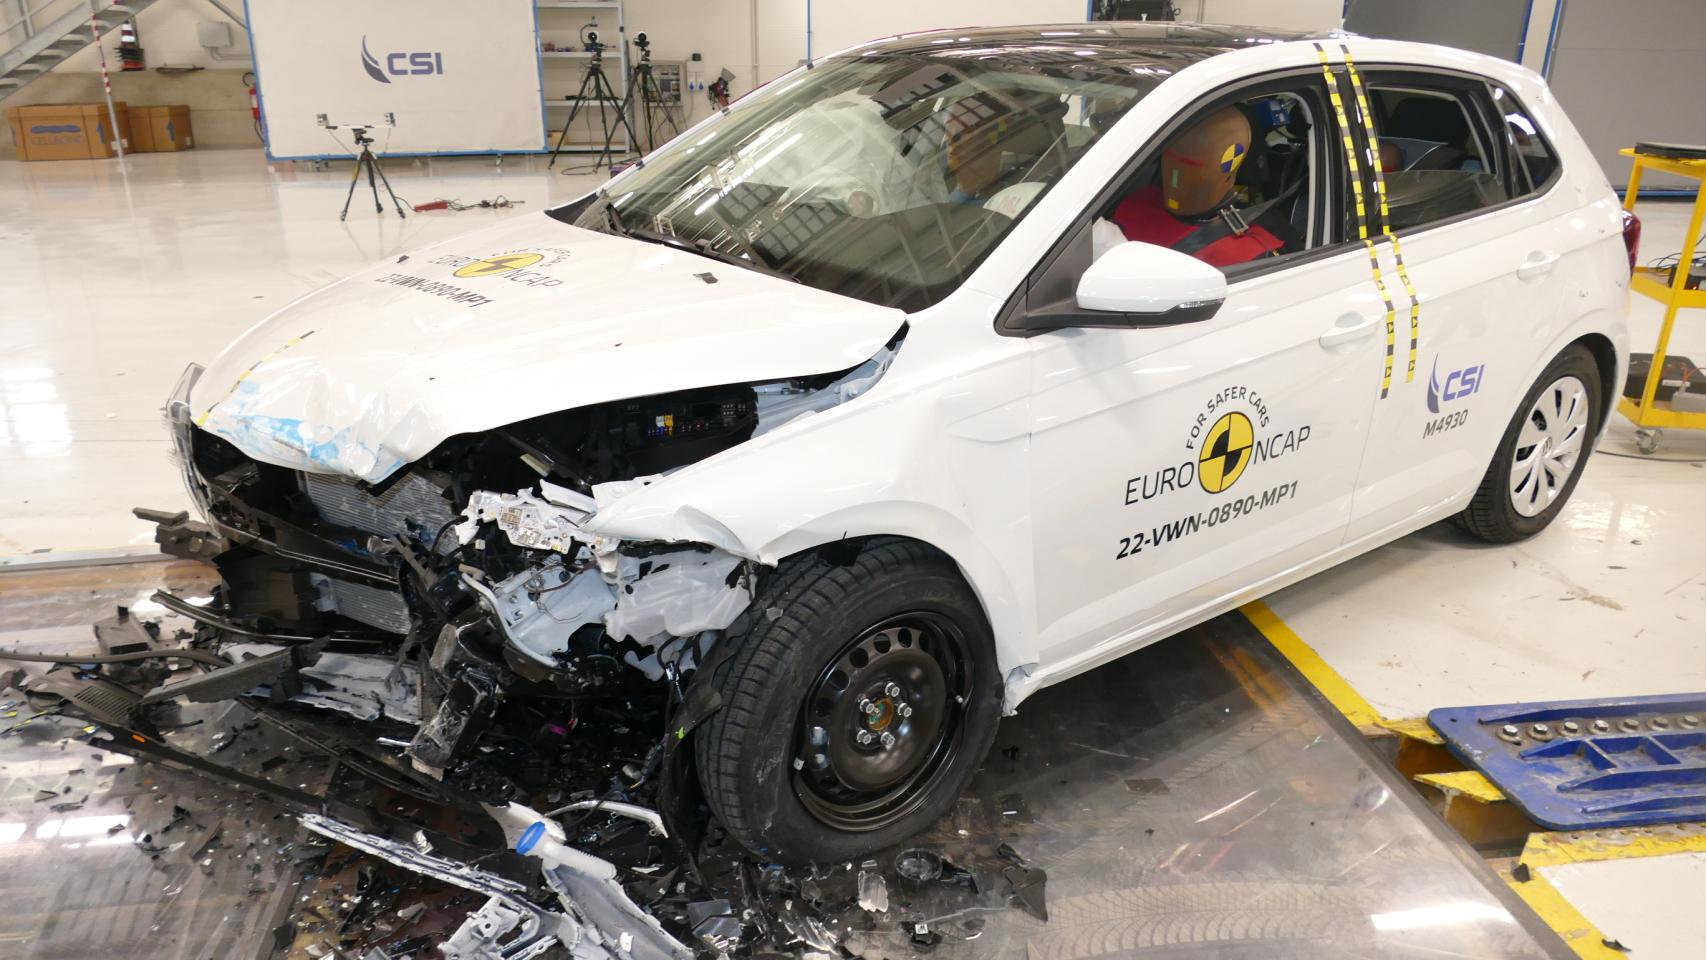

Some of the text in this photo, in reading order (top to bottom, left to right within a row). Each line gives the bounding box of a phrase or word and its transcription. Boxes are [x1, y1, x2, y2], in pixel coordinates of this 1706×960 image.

[387, 52, 443, 75] CSI
[498, 269, 565, 287] NCAP
[1442, 364, 1485, 402] CSI
[1186, 386, 1270, 450] FOR SAFER CARS
[1422, 408, 1469, 440] M4930
[1124, 425, 1311, 506] EURO NCAP
[1116, 480, 1298, 560] 22-VWN-0890-MP1
